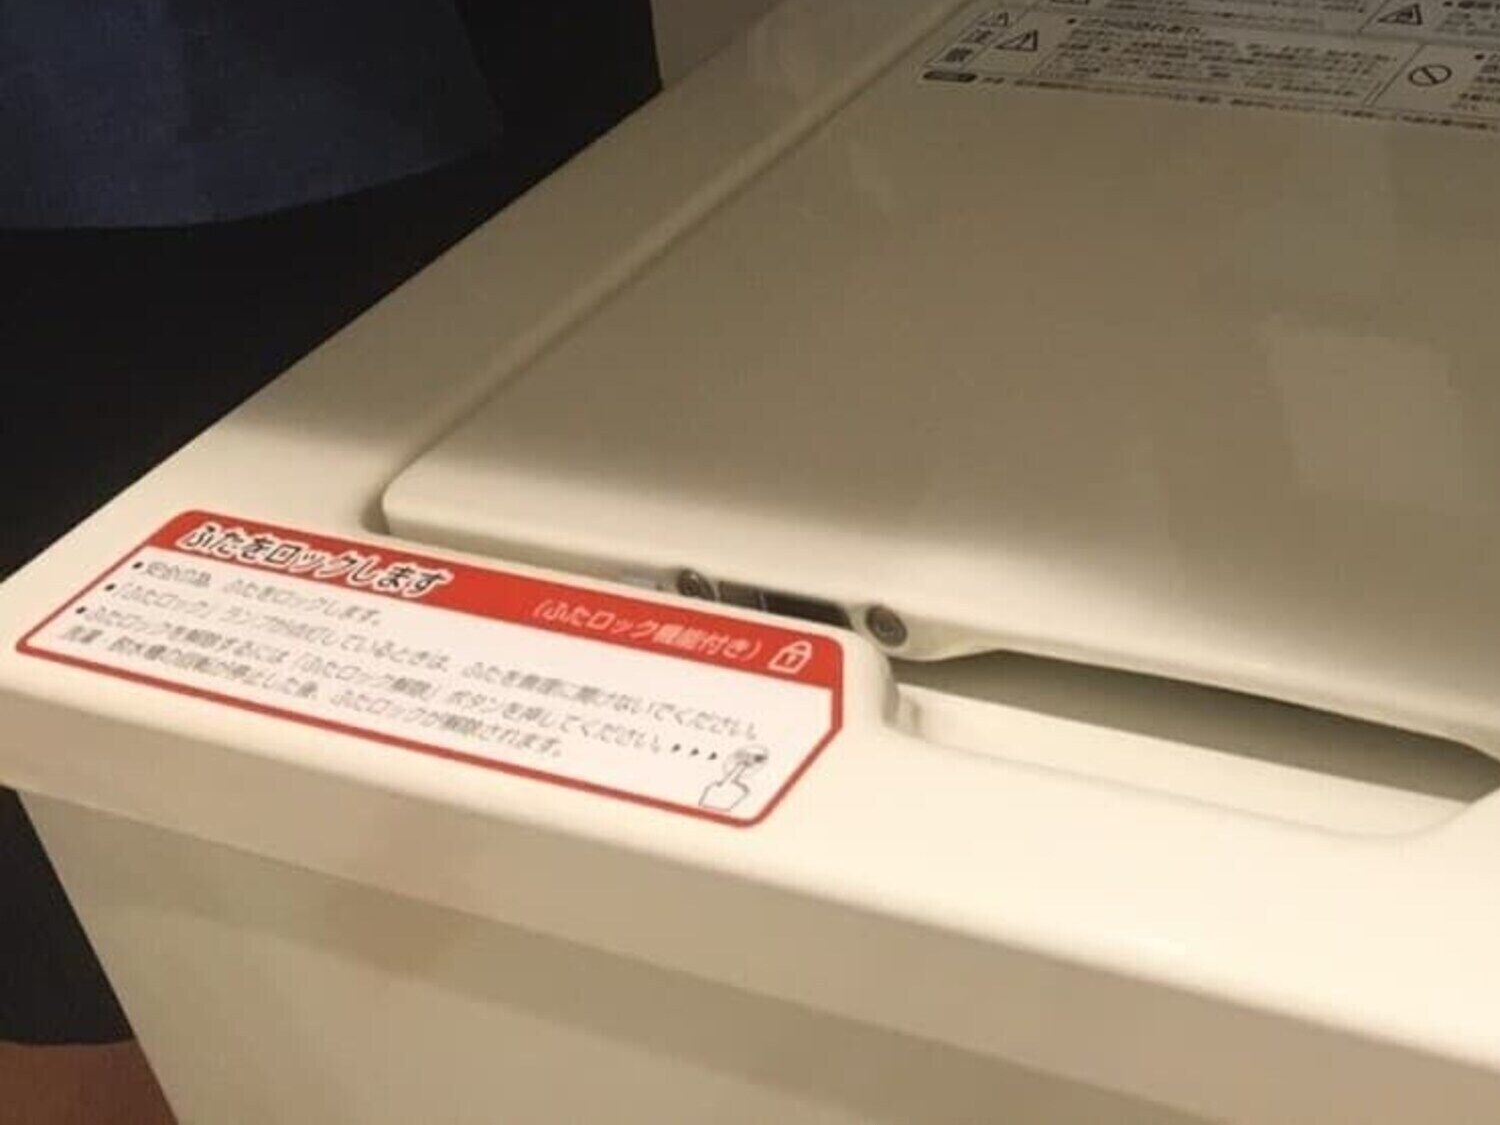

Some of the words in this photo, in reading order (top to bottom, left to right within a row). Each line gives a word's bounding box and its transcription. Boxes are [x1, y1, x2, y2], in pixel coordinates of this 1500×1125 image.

[180, 522, 452, 598] ふたをロックします
